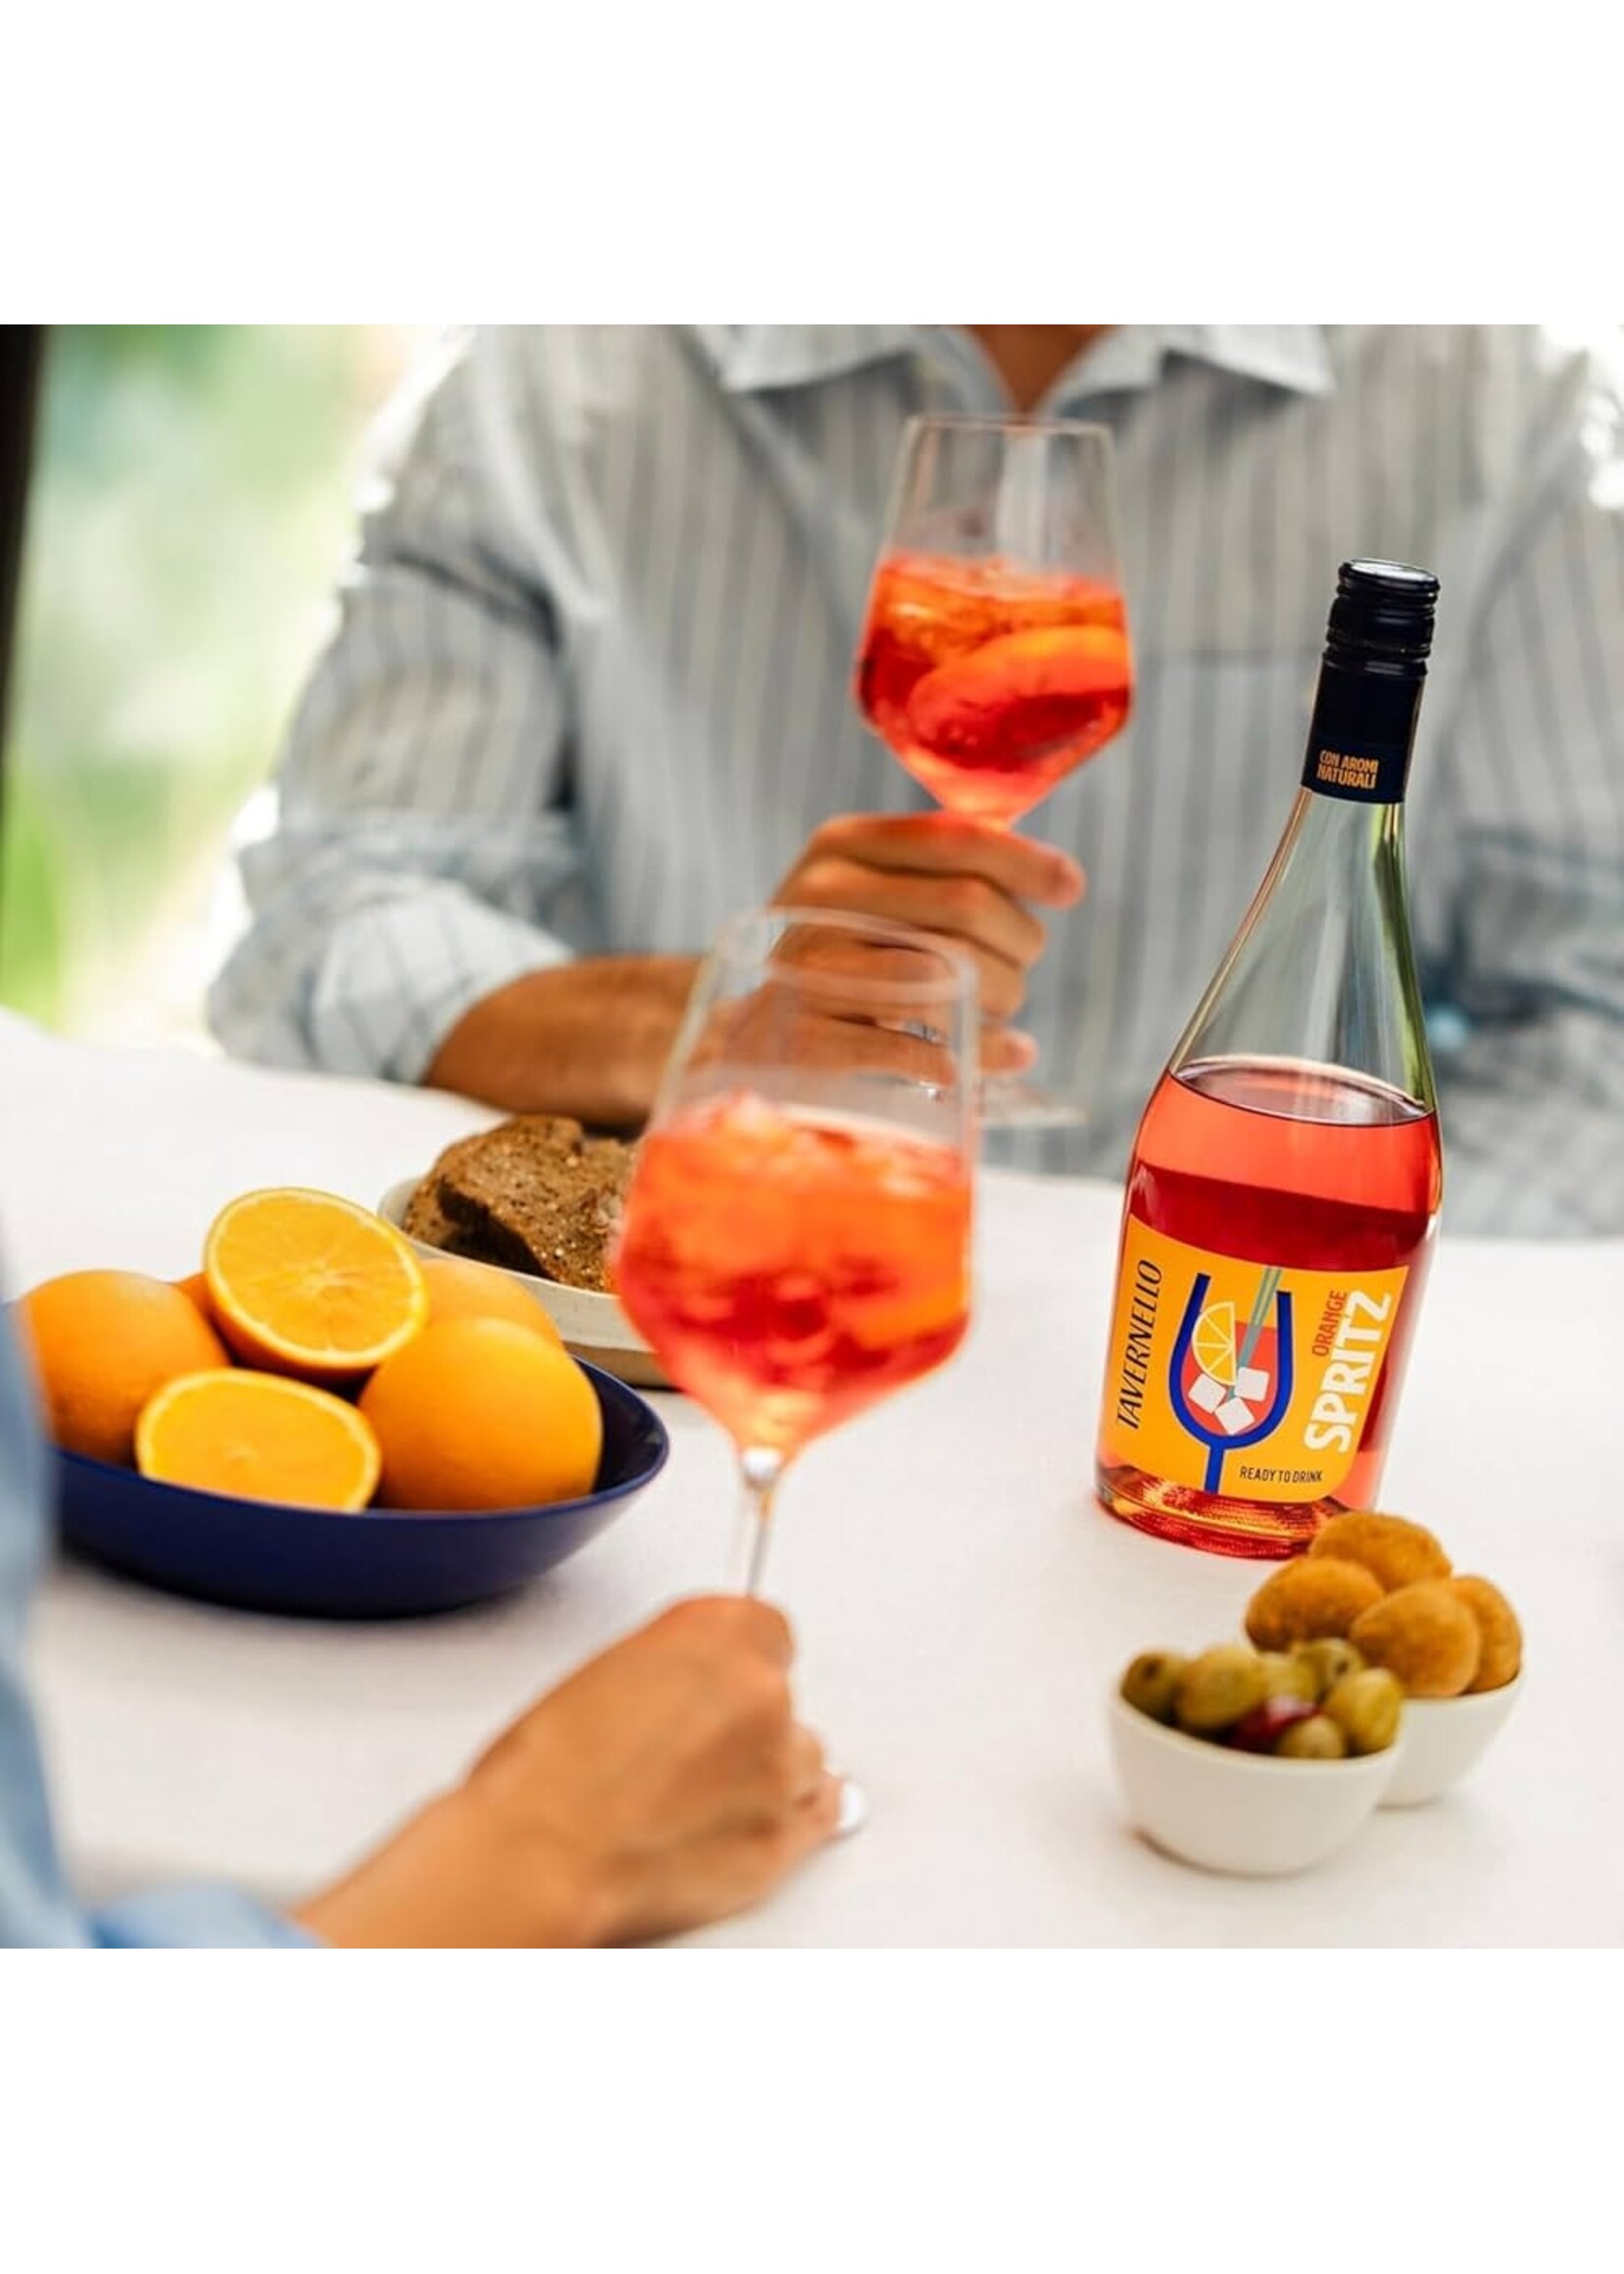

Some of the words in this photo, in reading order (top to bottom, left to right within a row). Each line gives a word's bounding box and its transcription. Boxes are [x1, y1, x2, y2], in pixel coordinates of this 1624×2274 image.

[1316, 763, 1377, 788] NATURALI
[1319, 750, 1340, 767] CON
[1341, 754, 1379, 774] AROMI
[1116, 1259, 1163, 1429] TAVERNELLO
[1311, 1290, 1348, 1357] ORANGE
[1304, 1290, 1392, 1453] SPRITZ
[1240, 1465, 1276, 1482] READY
[1278, 1470, 1291, 1483] TO
[1292, 1471, 1322, 1483] DRINK
